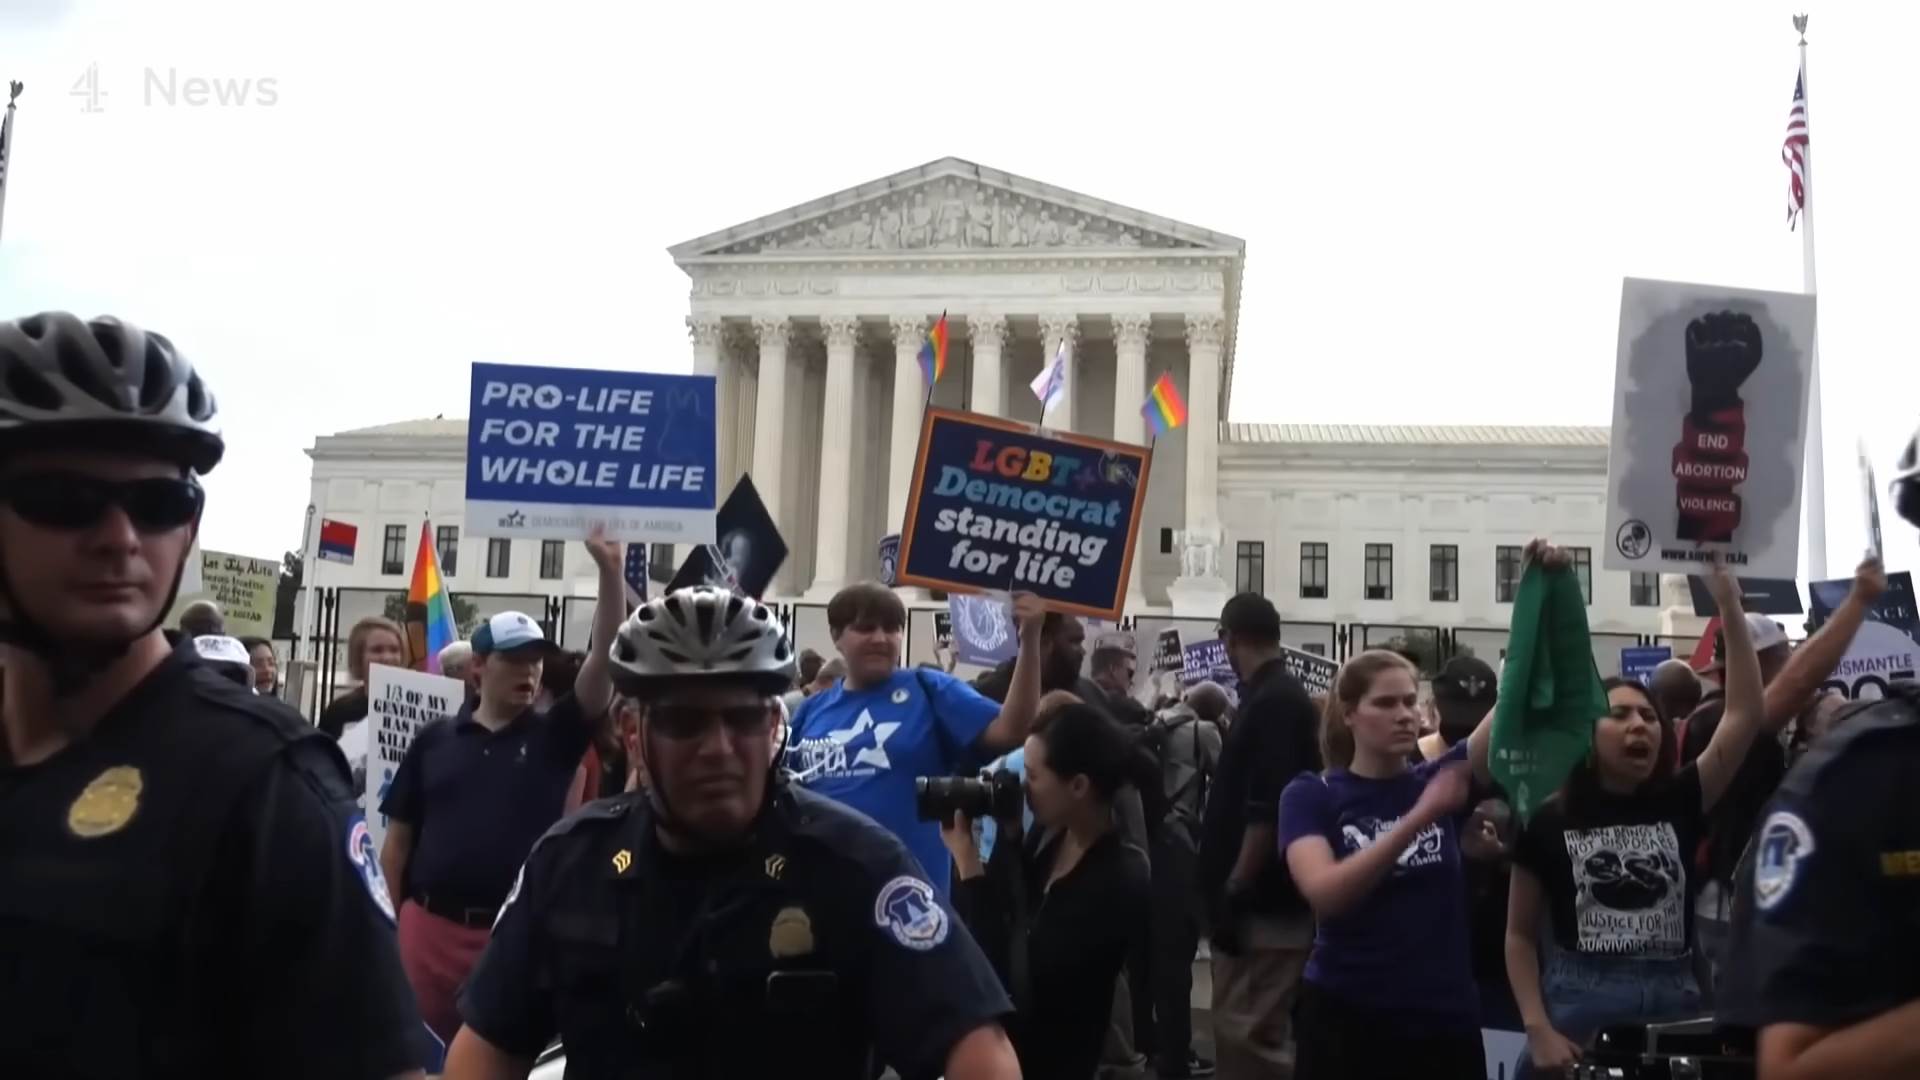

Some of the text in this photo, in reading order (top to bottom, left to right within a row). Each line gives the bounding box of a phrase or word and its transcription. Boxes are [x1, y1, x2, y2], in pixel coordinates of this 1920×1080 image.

[481, 381, 654, 415] PRO-LIFE
[479, 418, 646, 451] FOR THE
[1698, 434, 1729, 449] END
[480, 455, 706, 491] WHOLE LIFE
[1675, 463, 1745, 480] ABORTION
[933, 465, 1122, 528] Democrat
[1680, 497, 1735, 512] VIOLENCE
[934, 507, 1108, 566] standing
[949, 540, 1075, 588] for life
[386, 683, 449, 712] 1/3 OF MY
[382, 716, 410, 734] HAS
[1583, 911, 1633, 929] JUSTICE
